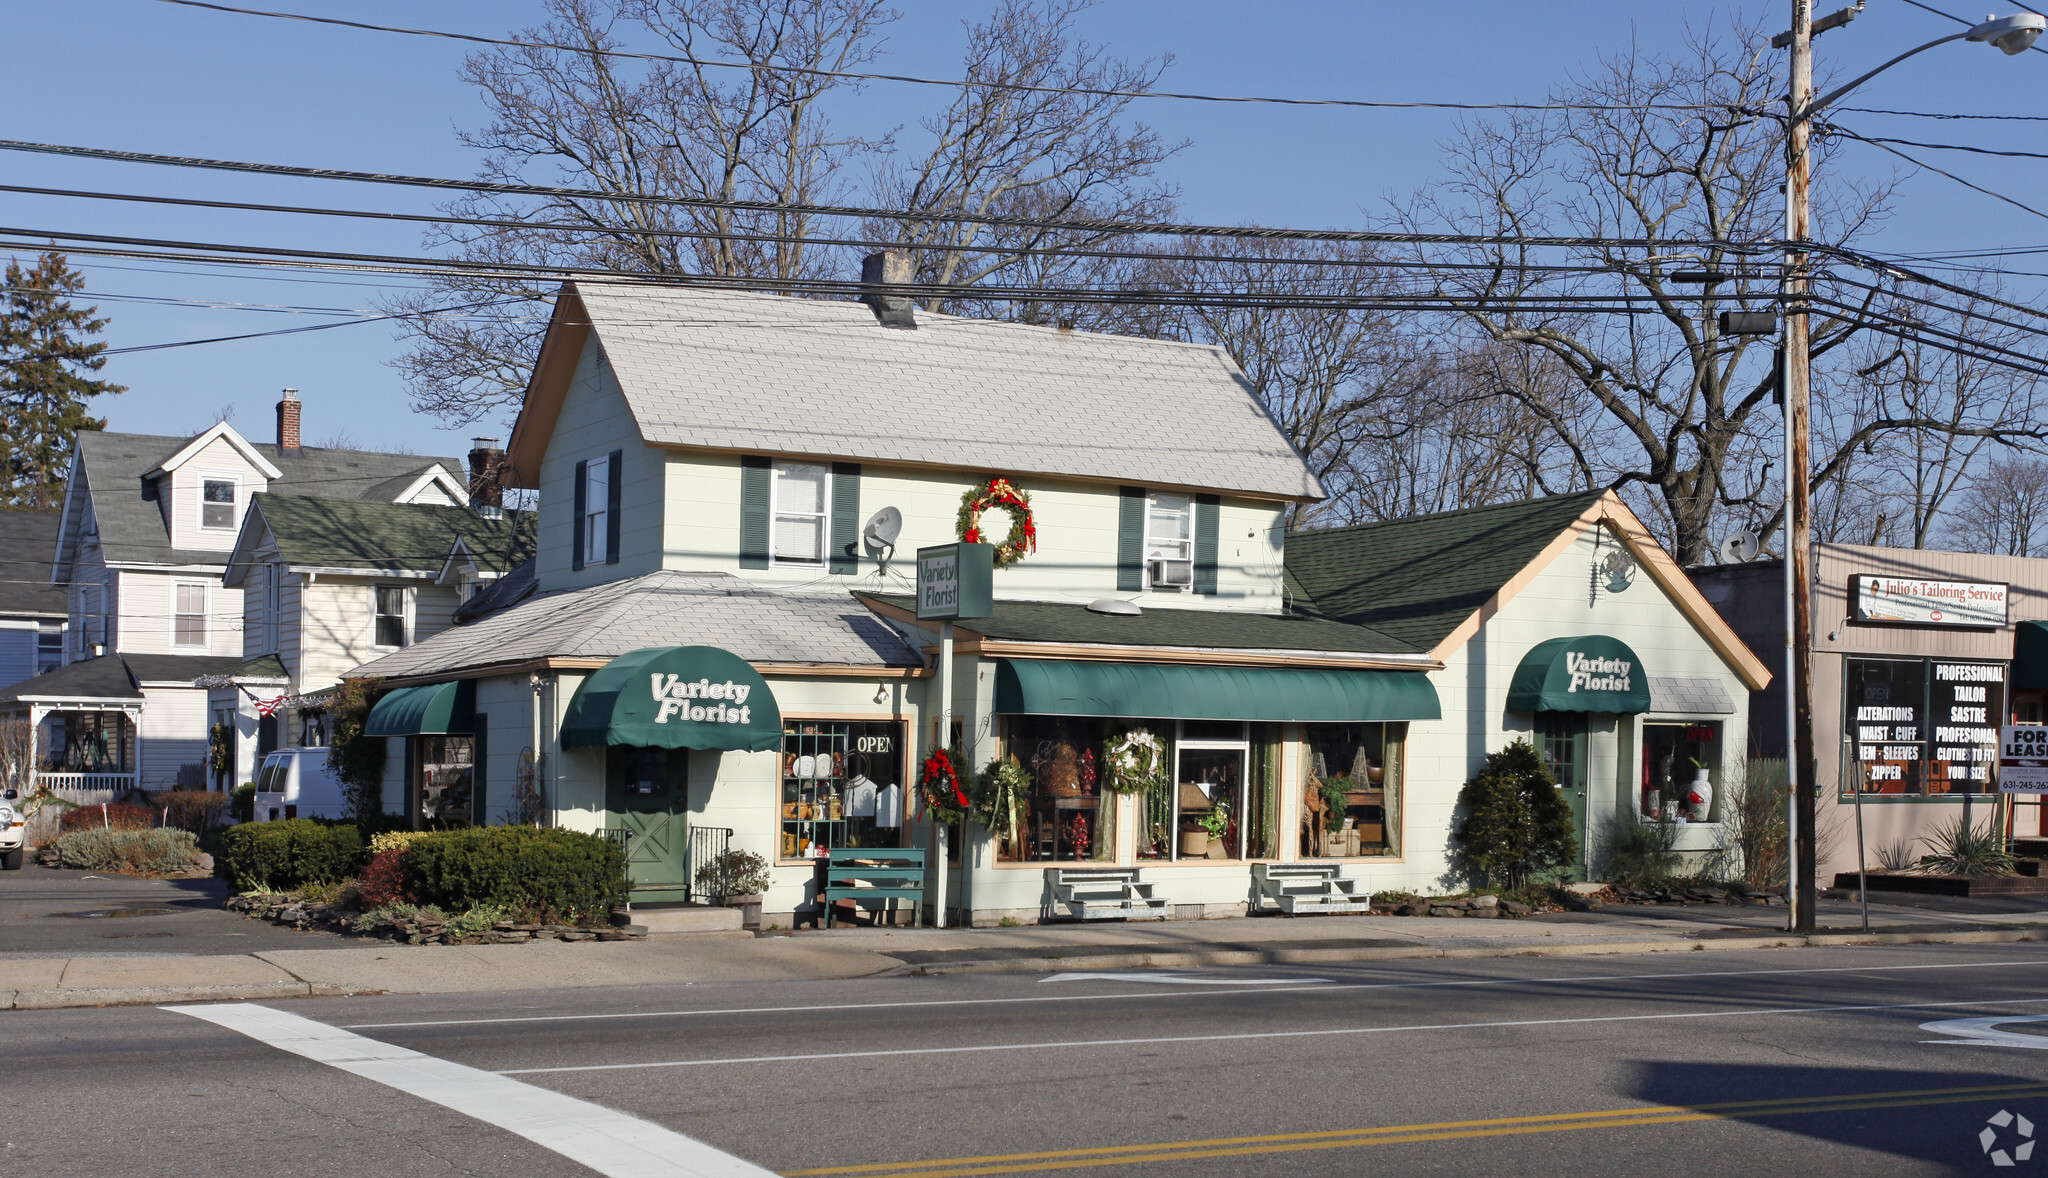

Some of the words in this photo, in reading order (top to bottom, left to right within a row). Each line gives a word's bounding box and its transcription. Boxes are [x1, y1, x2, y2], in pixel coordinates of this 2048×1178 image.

[920, 560, 954, 583] Variety
[926, 584, 957, 607] Florist
[1885, 580, 1918, 597] Julio's
[1920, 583, 1966, 603] Tailoring
[1968, 585, 2003, 601] Service
[1566, 651, 1631, 678] Variety
[1936, 664, 2003, 682] PROFESSIONAL
[651, 672, 751, 705] Variety
[1567, 671, 1630, 693] Florist
[1953, 685, 1986, 703] TAILOR
[654, 697, 751, 725] Florist
[1857, 706, 1913, 722] ALTERATIONS
[1950, 706, 1987, 723] SASTRE
[1859, 725, 1889, 741] WAIST
[1895, 726, 1917, 741] CUFF
[1935, 726, 1996, 744] PROFESIONAL
[2014, 730, 2047, 743] FOR
[857, 736, 894, 752] OPEN
[2006, 744, 2048, 756] LEAS
[1883, 746, 1919, 761] SLEEVES
[1937, 747, 1971, 761] CLOTHES
[1972, 748, 1983, 762] TO
[1984, 748, 1996, 762] FIT
[1871, 765, 1902, 780] ZIPPER
[1947, 766, 1968, 779] YOUR
[1970, 766, 1986, 779] SIZE
